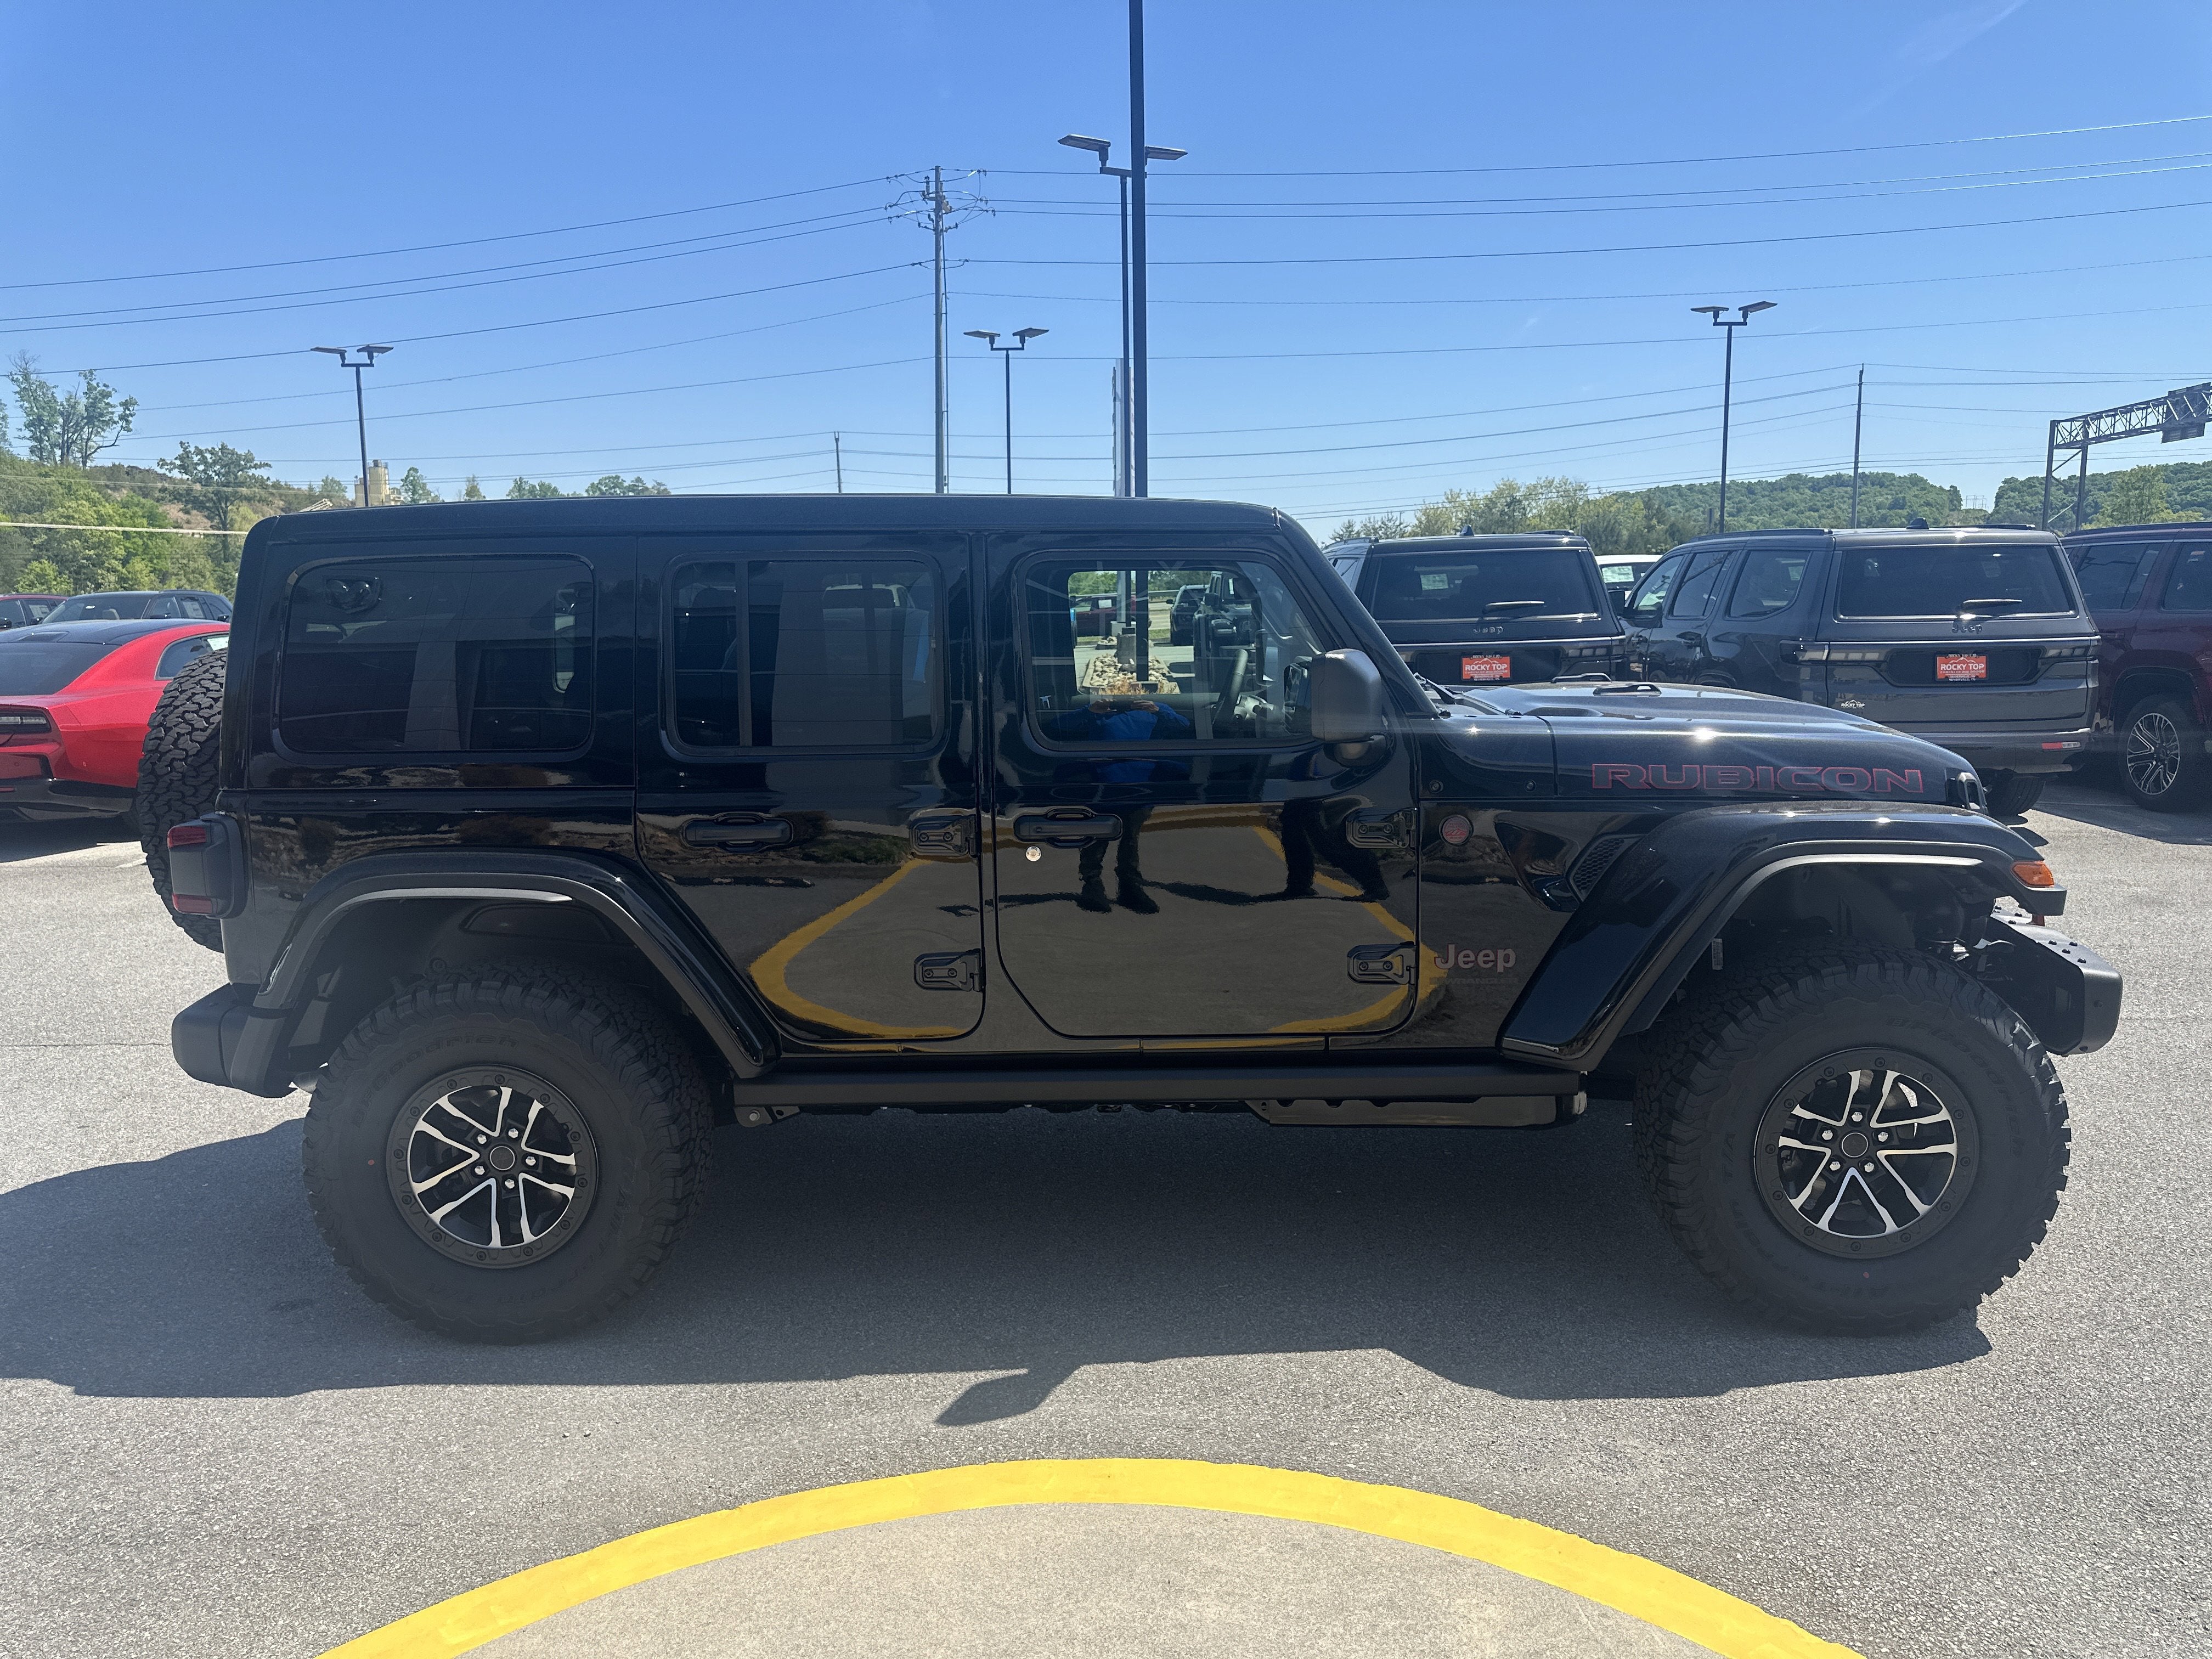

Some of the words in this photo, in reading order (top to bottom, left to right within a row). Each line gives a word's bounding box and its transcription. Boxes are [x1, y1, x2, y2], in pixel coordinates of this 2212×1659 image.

[1951, 623, 1982, 634] Jeep
[1592, 763, 1923, 793] RUBICON
[1434, 943, 1516, 974] Jeep
